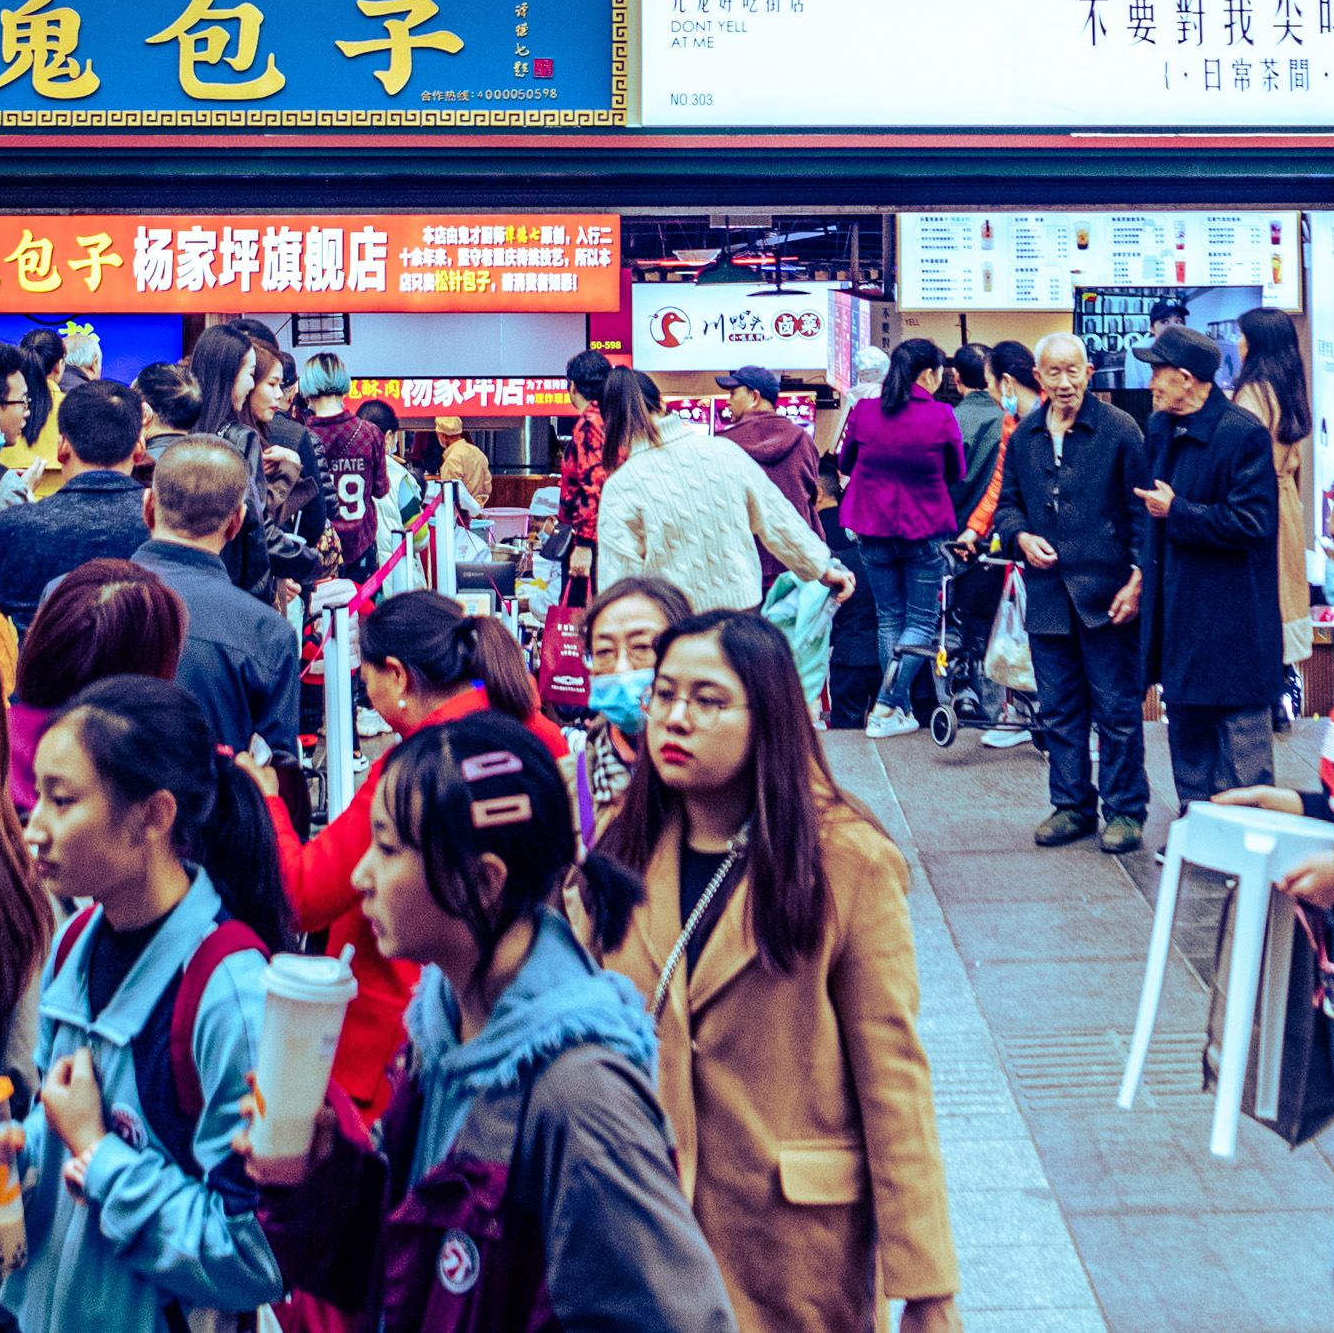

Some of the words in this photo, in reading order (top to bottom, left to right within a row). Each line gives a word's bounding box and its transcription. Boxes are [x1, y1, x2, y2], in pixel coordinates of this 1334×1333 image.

[670, 20, 711, 34] DONT
[717, 20, 749, 33] YELL
[670, 36, 689, 49] AT
[693, 36, 715, 49] ME
[132, 225, 389, 295] 杨家坪旗舰店
